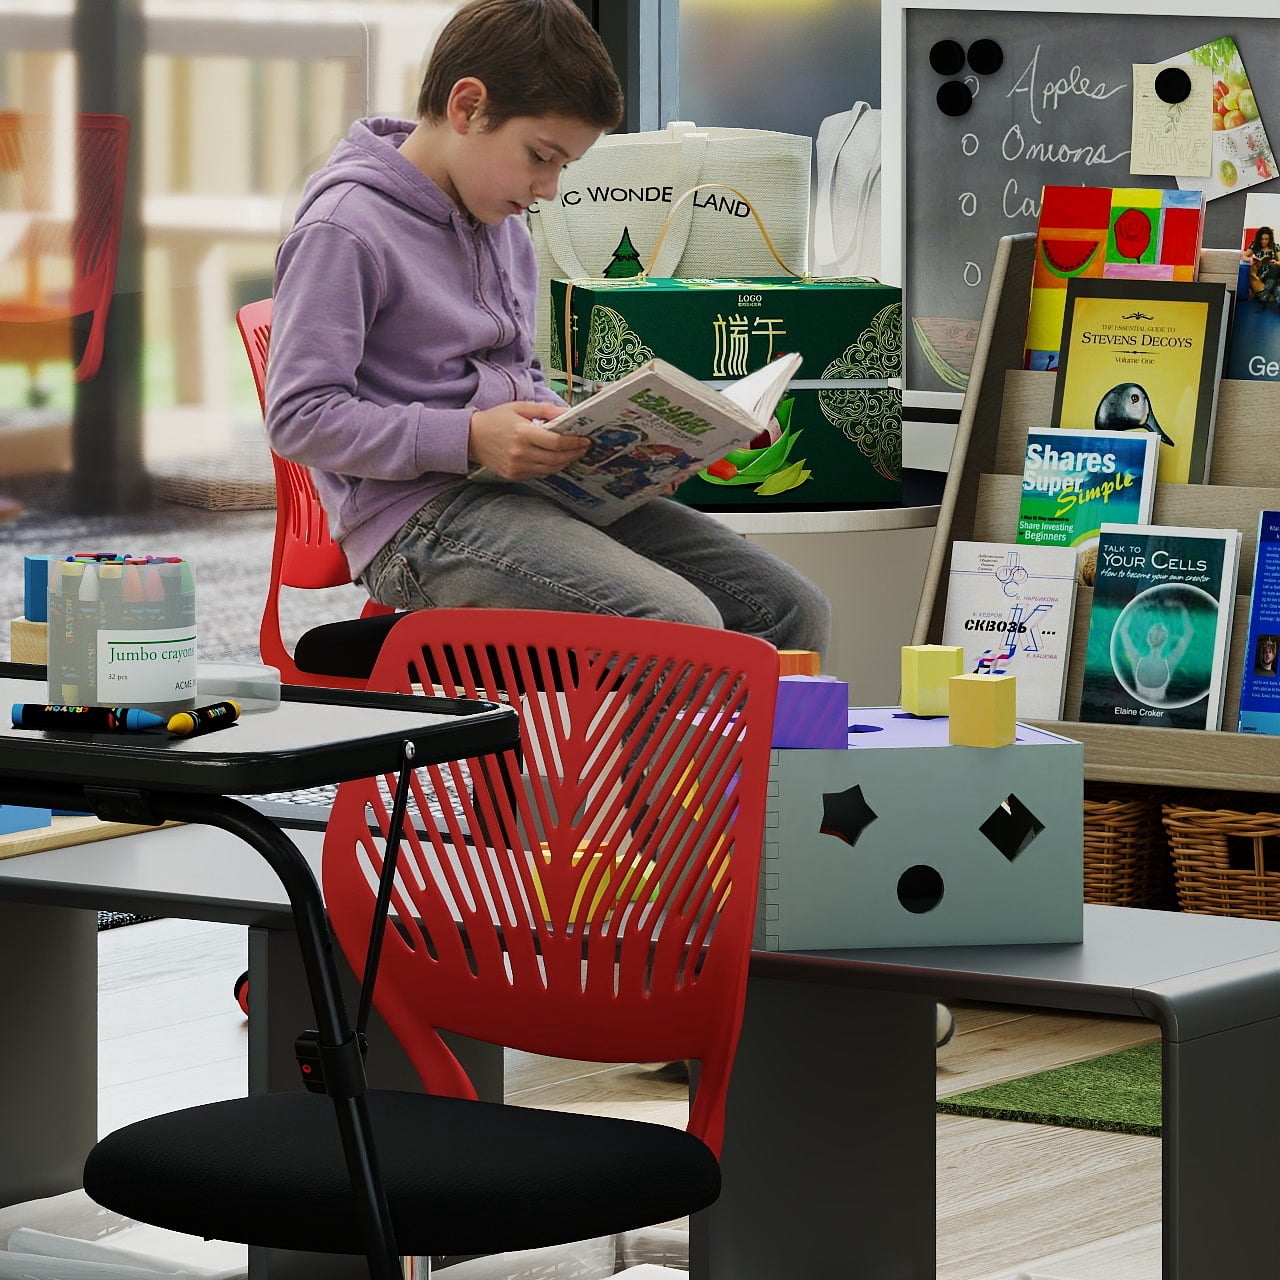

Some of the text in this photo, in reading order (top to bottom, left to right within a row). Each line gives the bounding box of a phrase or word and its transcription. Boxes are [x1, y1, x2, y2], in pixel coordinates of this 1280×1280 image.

[1006, 44, 1128, 124] Apples
[1001, 124, 1131, 166] Onions
[738, 294, 763, 303] LOGO
[713, 313, 786, 376] 端午
[1081, 331, 1193, 348] STEVENS DECOYS
[1026, 443, 1116, 473] Shares
[1022, 469, 1085, 496] Super
[1054, 471, 1134, 517] Simple
[1019, 520, 1074, 533] Share Investing
[1025, 530, 1067, 542] Beginners
[1103, 544, 1125, 553] TALK
[1102, 551, 1207, 571] YOUR CELLS
[1100, 567, 1118, 577] How
[1118, 569, 1126, 577] to
[1126, 569, 1150, 579] become
[1150, 572, 1168, 582] your
[1185, 574, 1211, 582] creator
[65, 598, 74, 644] CRAYON
[108, 646, 157, 664] Jumbo
[175, 681, 192, 691] ACME
[44, 705, 89, 713] CRAYON
[1114, 706, 1164, 718] Elaine Croker
